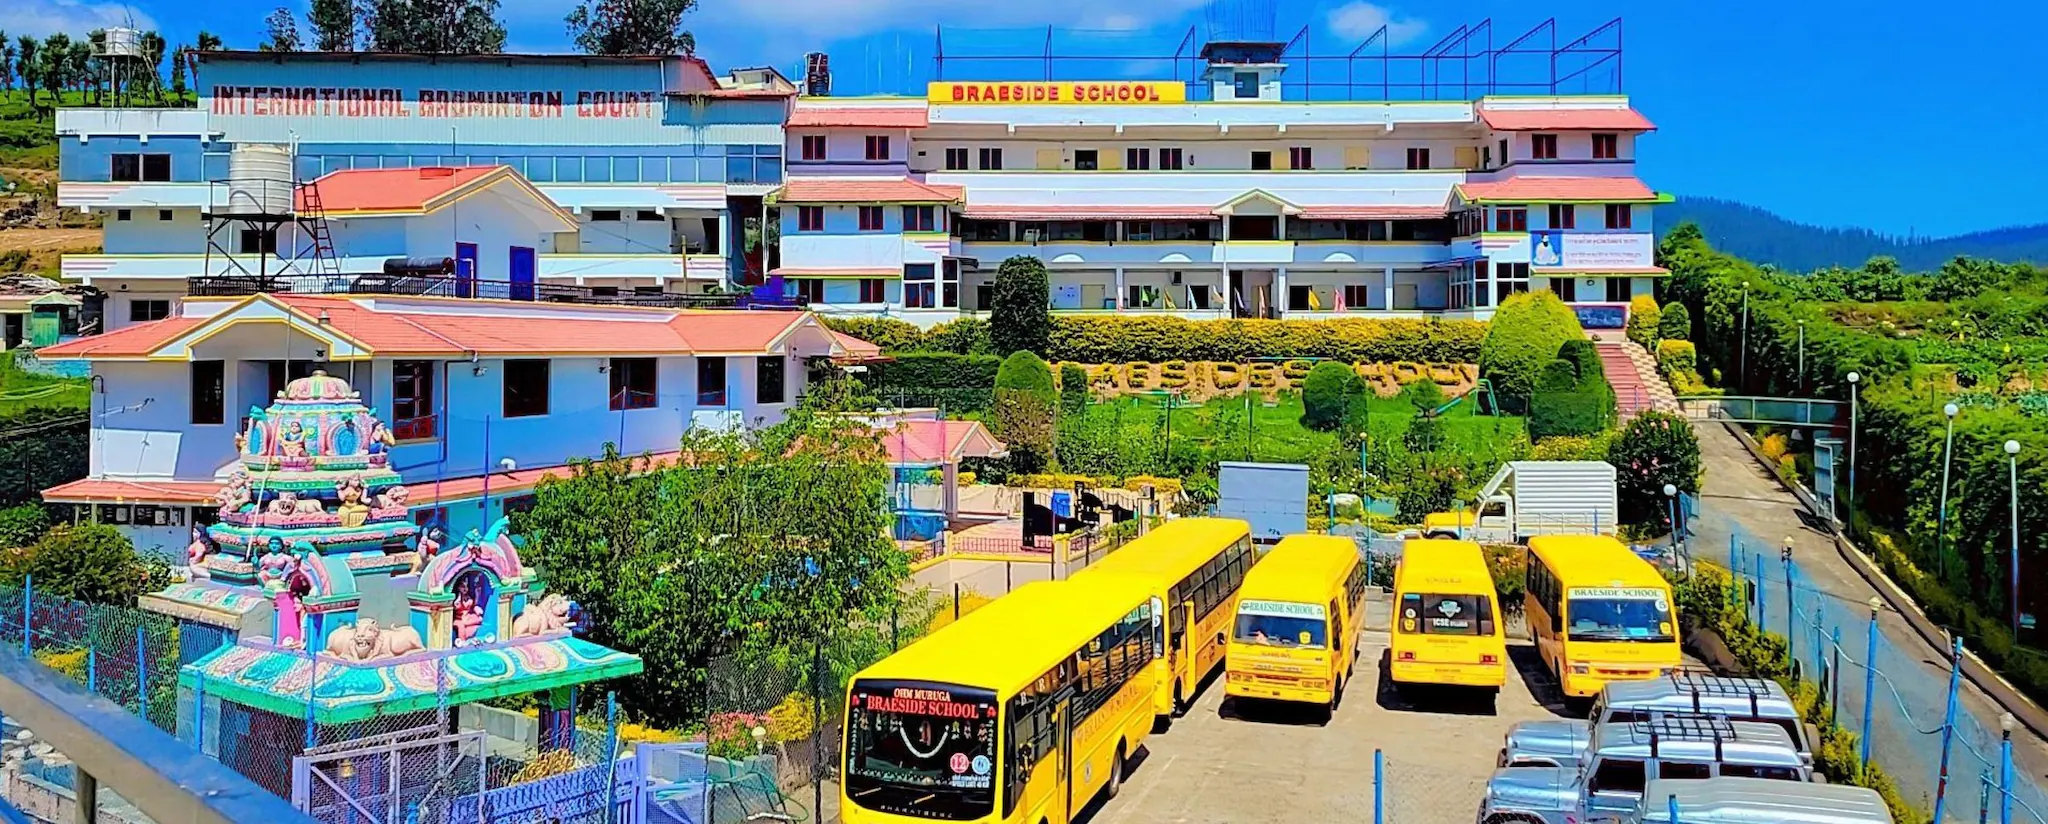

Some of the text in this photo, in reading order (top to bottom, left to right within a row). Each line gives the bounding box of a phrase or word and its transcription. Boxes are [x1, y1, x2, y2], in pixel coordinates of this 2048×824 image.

[952, 85, 1160, 101] BRAESIDE SCHOOL
[213, 86, 658, 119] INTERNATIONAL BADMINTON COURT
[1574, 589, 1659, 597] BRAESIDE SCHOOL
[1249, 602, 1315, 615] BRAESIDE SCHOOL
[893, 688, 951, 702] OHM MURUGA
[867, 695, 980, 719] BRAESIDE SCHOOL
